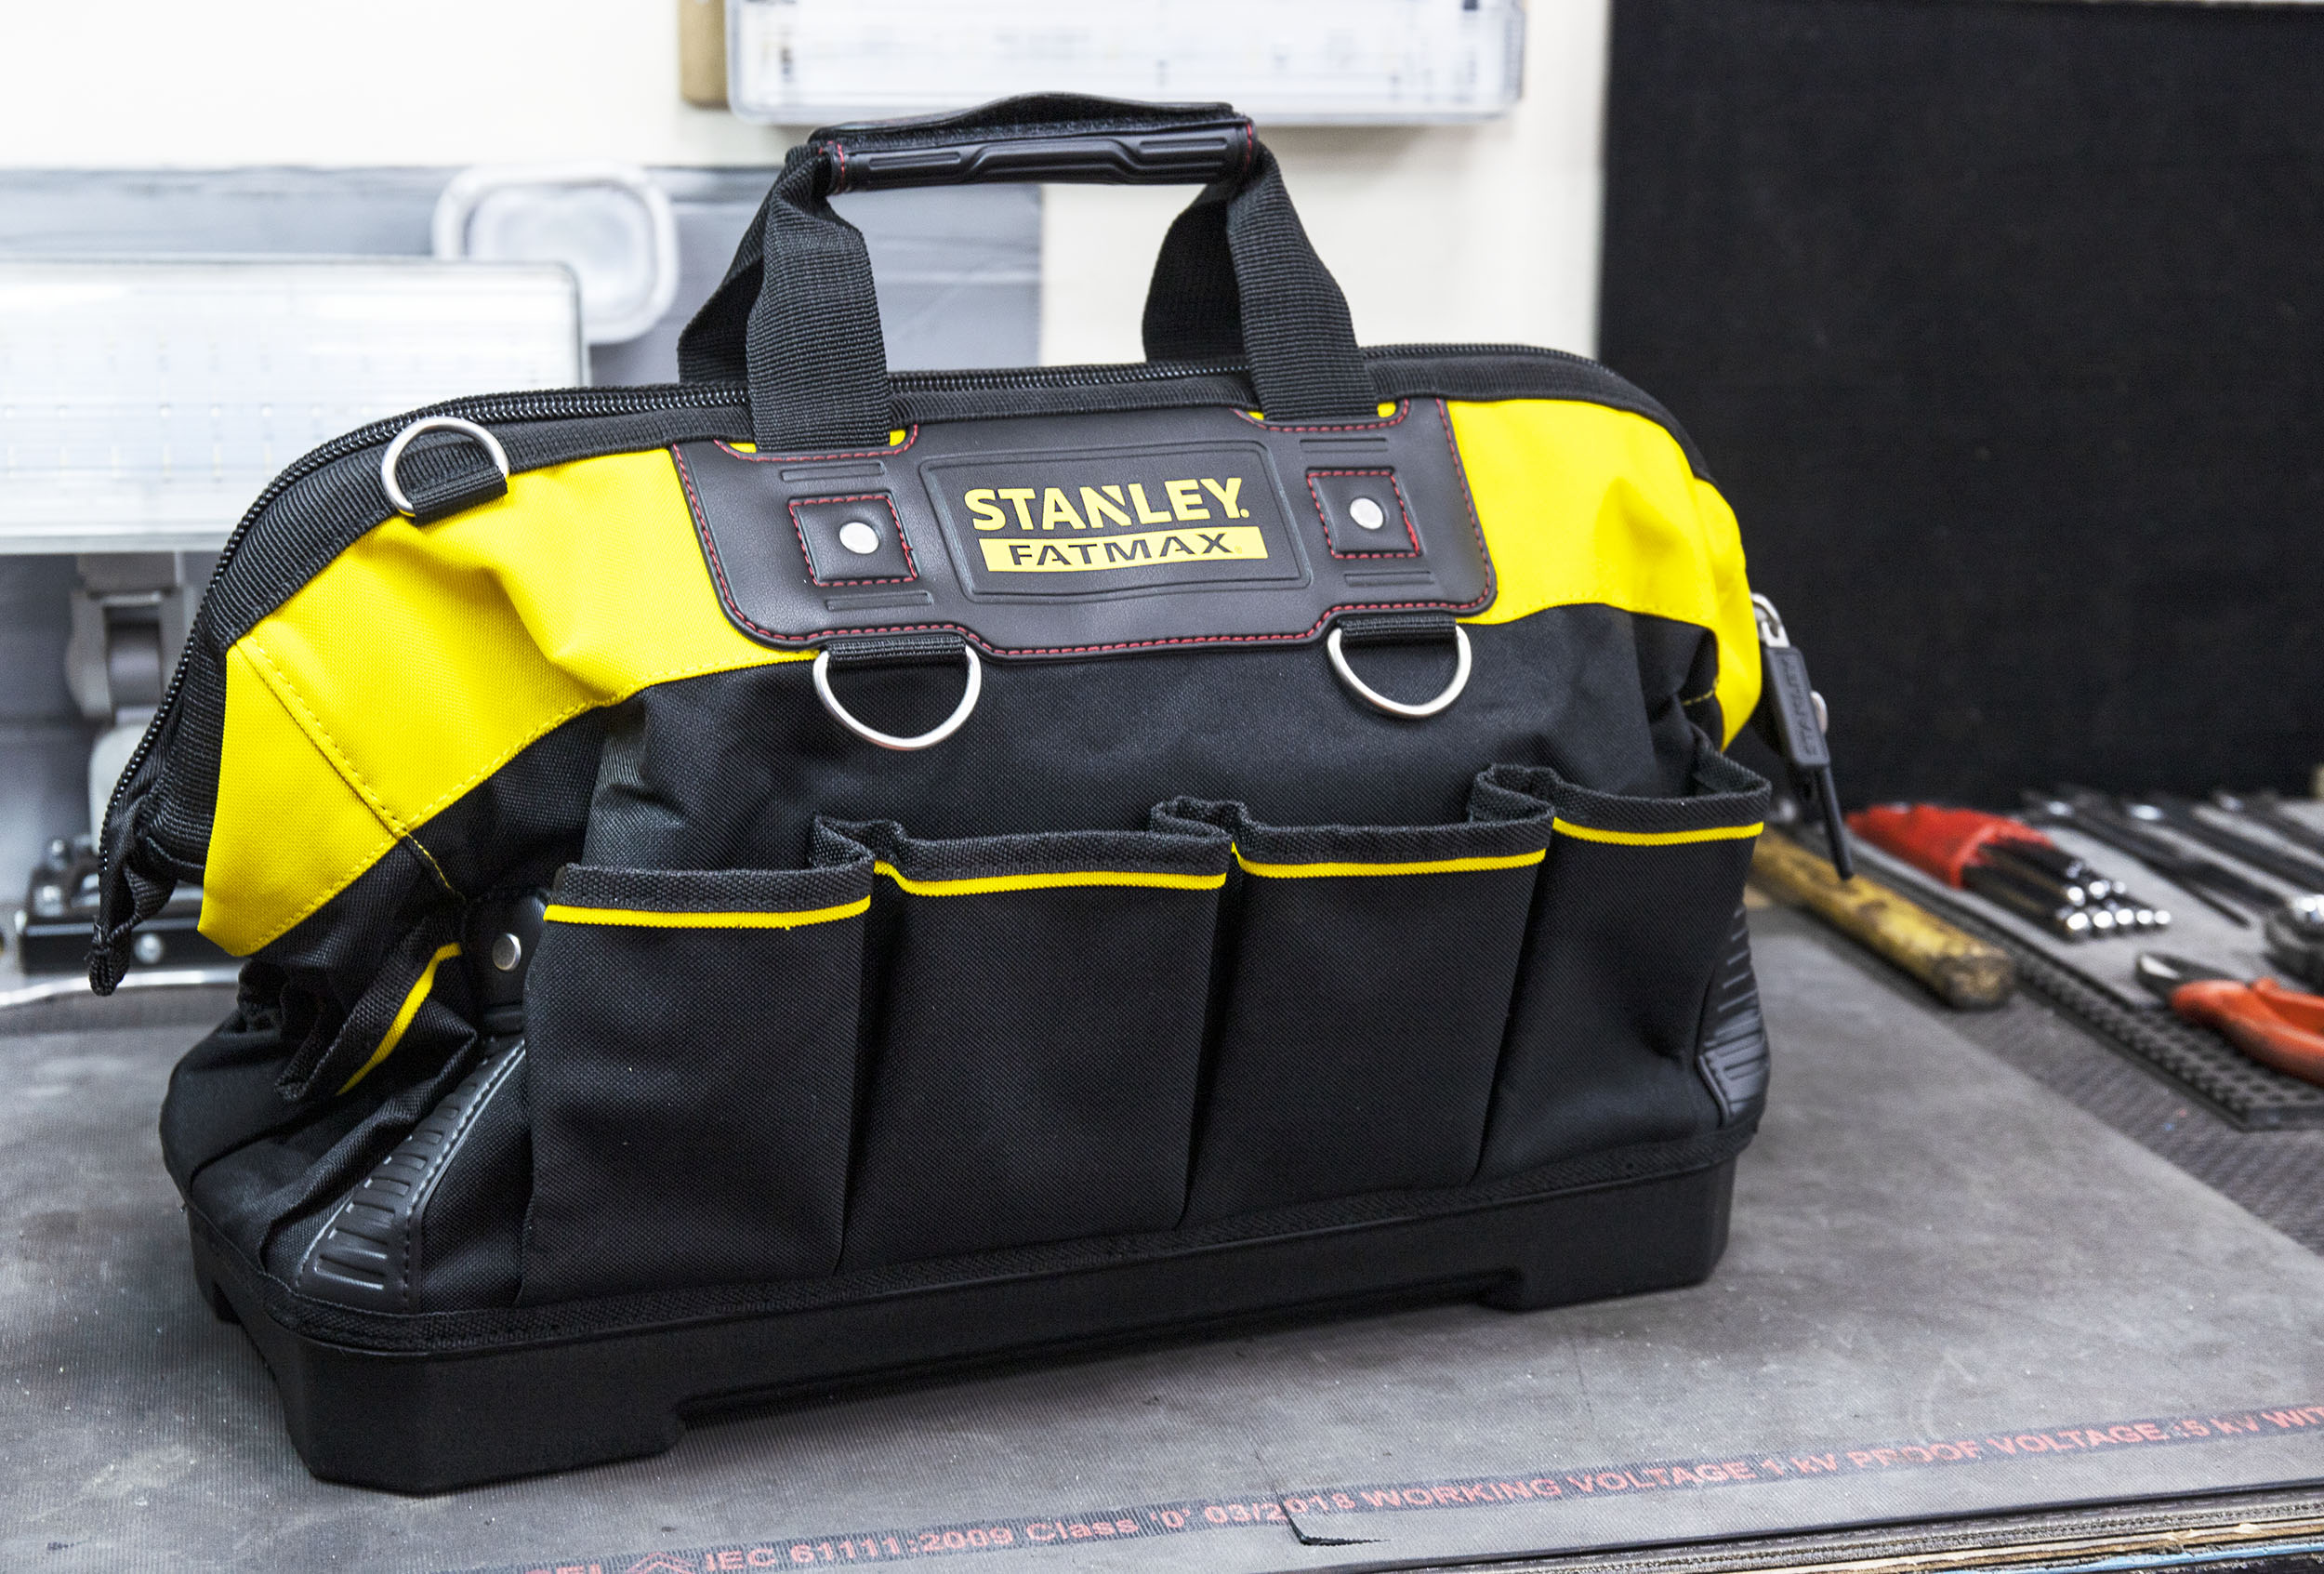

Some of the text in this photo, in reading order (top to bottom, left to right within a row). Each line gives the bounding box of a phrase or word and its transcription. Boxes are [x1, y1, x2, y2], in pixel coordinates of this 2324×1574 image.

[1009, 533, 1234, 566] FATMAX
[706, 1548, 776, 1572] IEC
[790, 1527, 1015, 1564] 61111:2009
[1026, 1519, 1139, 1541] Class
[1205, 1493, 1356, 1524] 03/2018
[1361, 1478, 1562, 1507] WORKING
[1566, 1462, 1757, 1492] VOLTAGE
[1846, 1440, 1980, 1468] PROOF
